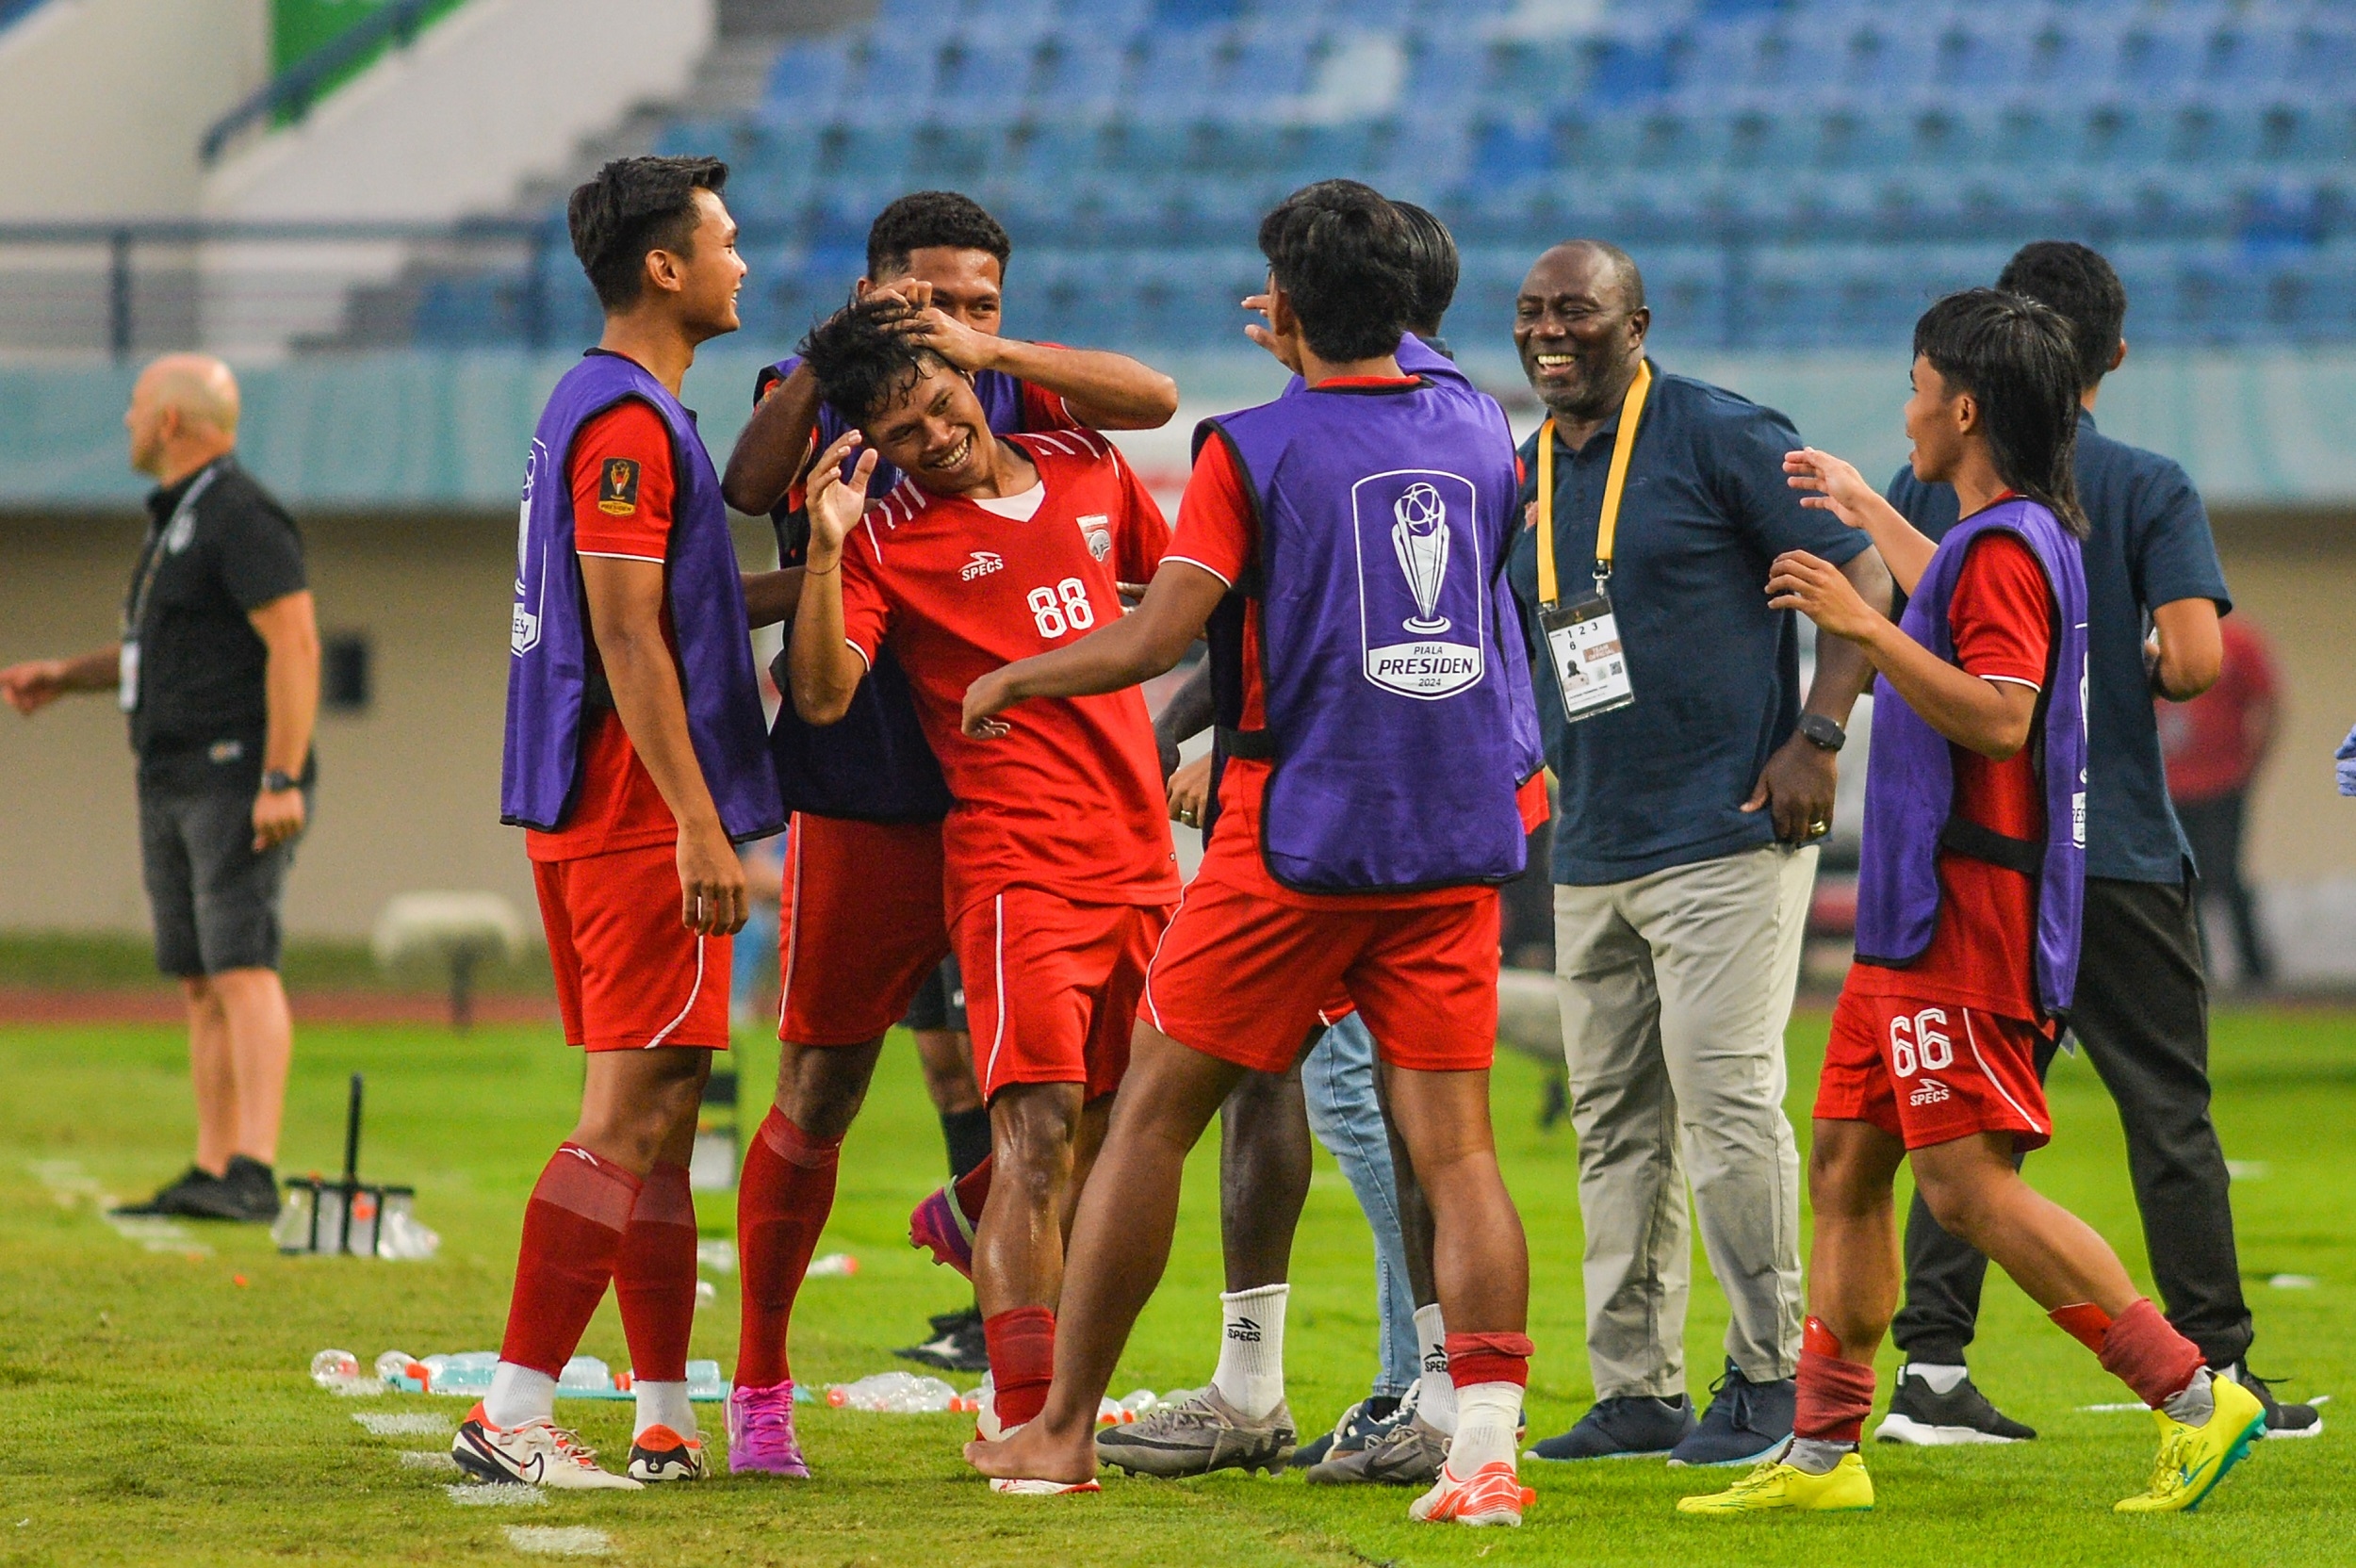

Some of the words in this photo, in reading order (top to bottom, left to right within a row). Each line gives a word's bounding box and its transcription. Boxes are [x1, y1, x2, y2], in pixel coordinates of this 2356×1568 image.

[961, 558, 1004, 581] SPECS
[1026, 577, 1094, 639] 88
[1579, 626, 1585, 635] 2
[1592, 622, 1598, 631] 3
[1414, 645, 1443, 655] PIALA
[1569, 641, 1576, 650] 6
[1378, 658, 1473, 675] PRESIDEN
[1418, 678, 1441, 687] 2024
[1890, 1007, 1954, 1078] 66
[1909, 1088, 1950, 1107] SPECS
[1227, 1328, 1261, 1342] SPECS
[1424, 1361, 1448, 1373] SPEC
